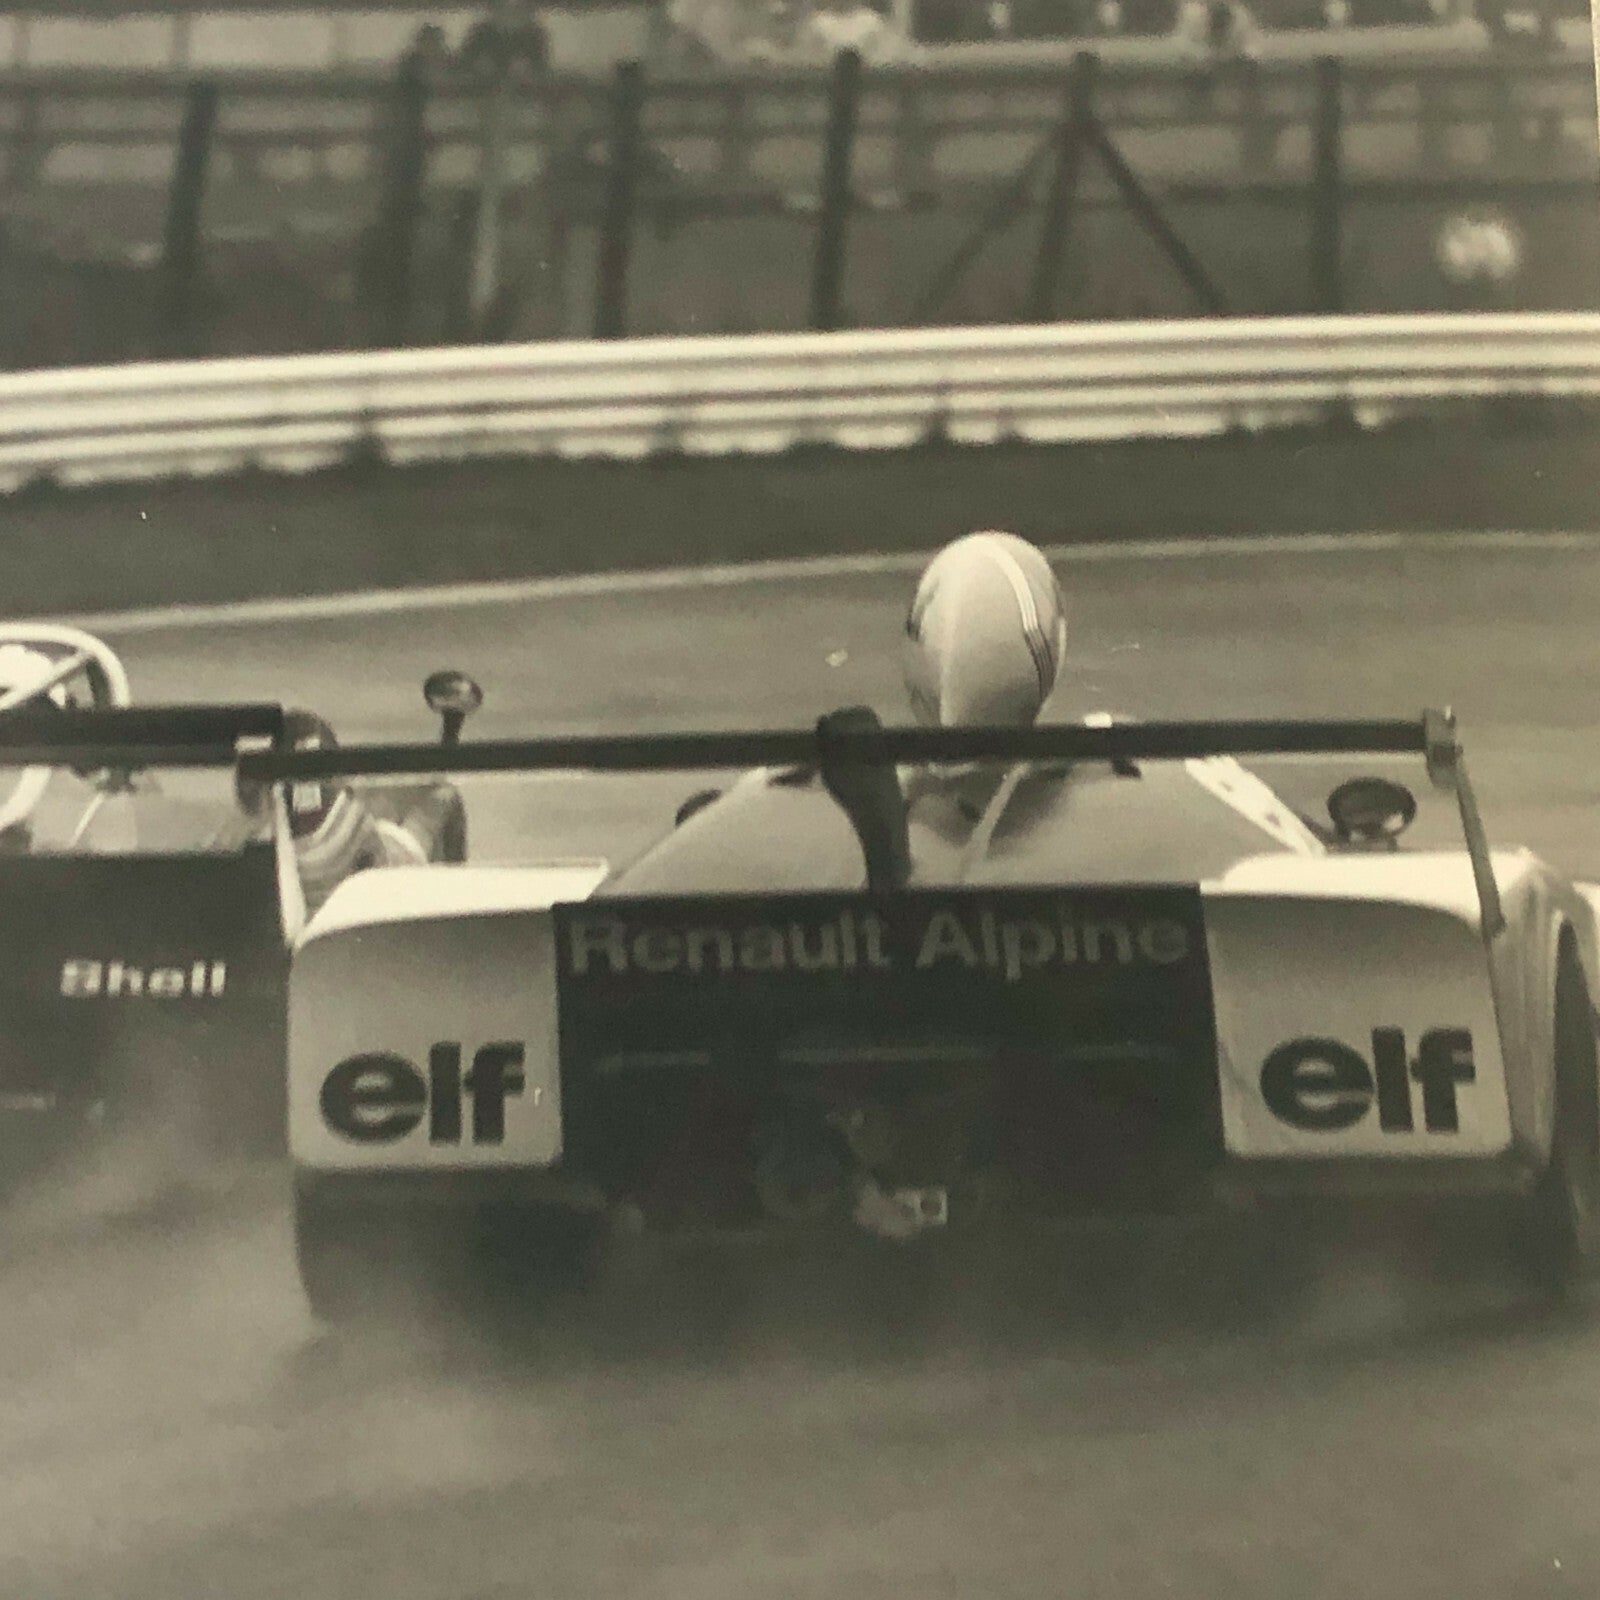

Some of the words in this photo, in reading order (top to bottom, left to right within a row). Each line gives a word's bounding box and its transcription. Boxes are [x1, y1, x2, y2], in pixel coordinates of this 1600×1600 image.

[61, 960, 226, 997] Shell
[567, 908, 893, 975] Renault
[915, 907, 1190, 982] Alpine
[319, 1040, 526, 1146] elf
[1259, 1026, 1476, 1134] elf
